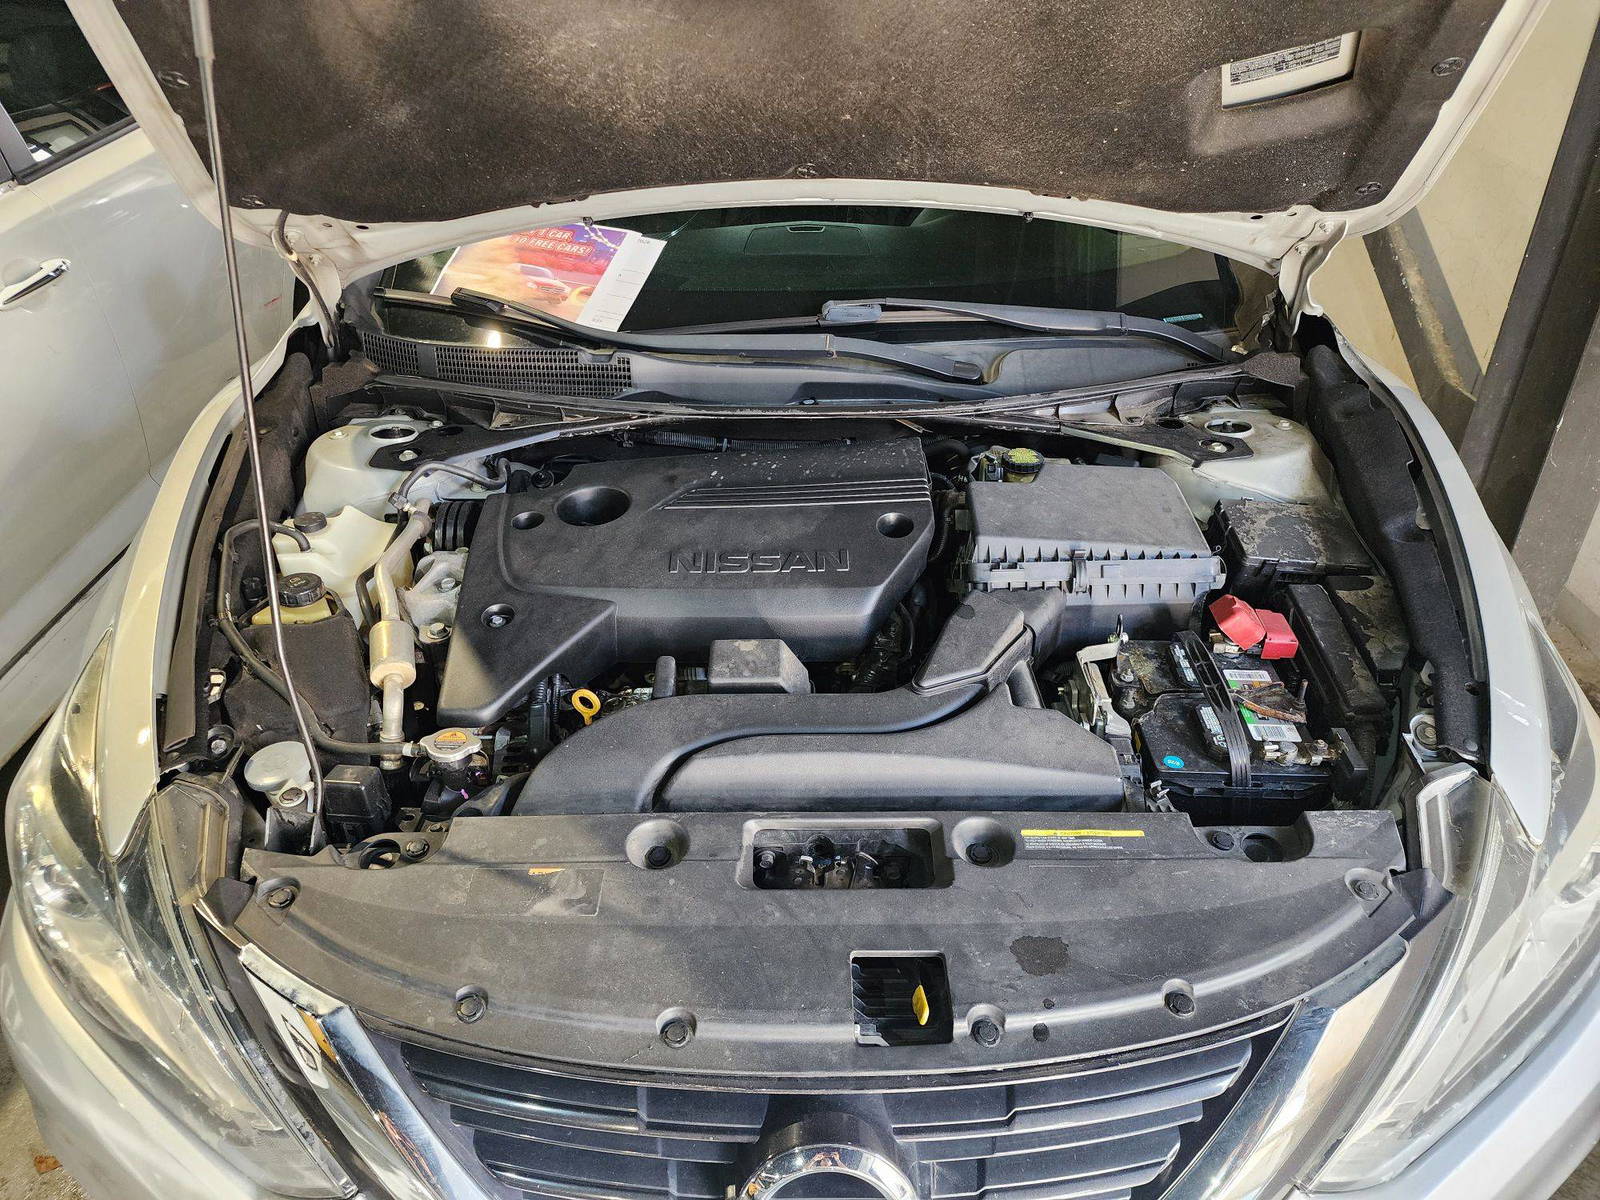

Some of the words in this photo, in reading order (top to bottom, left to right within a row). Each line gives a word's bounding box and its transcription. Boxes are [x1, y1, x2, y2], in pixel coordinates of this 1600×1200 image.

[548, 230, 572, 240] CAR
[529, 238, 554, 249] FREE
[669, 549, 850, 574] NISSAN
